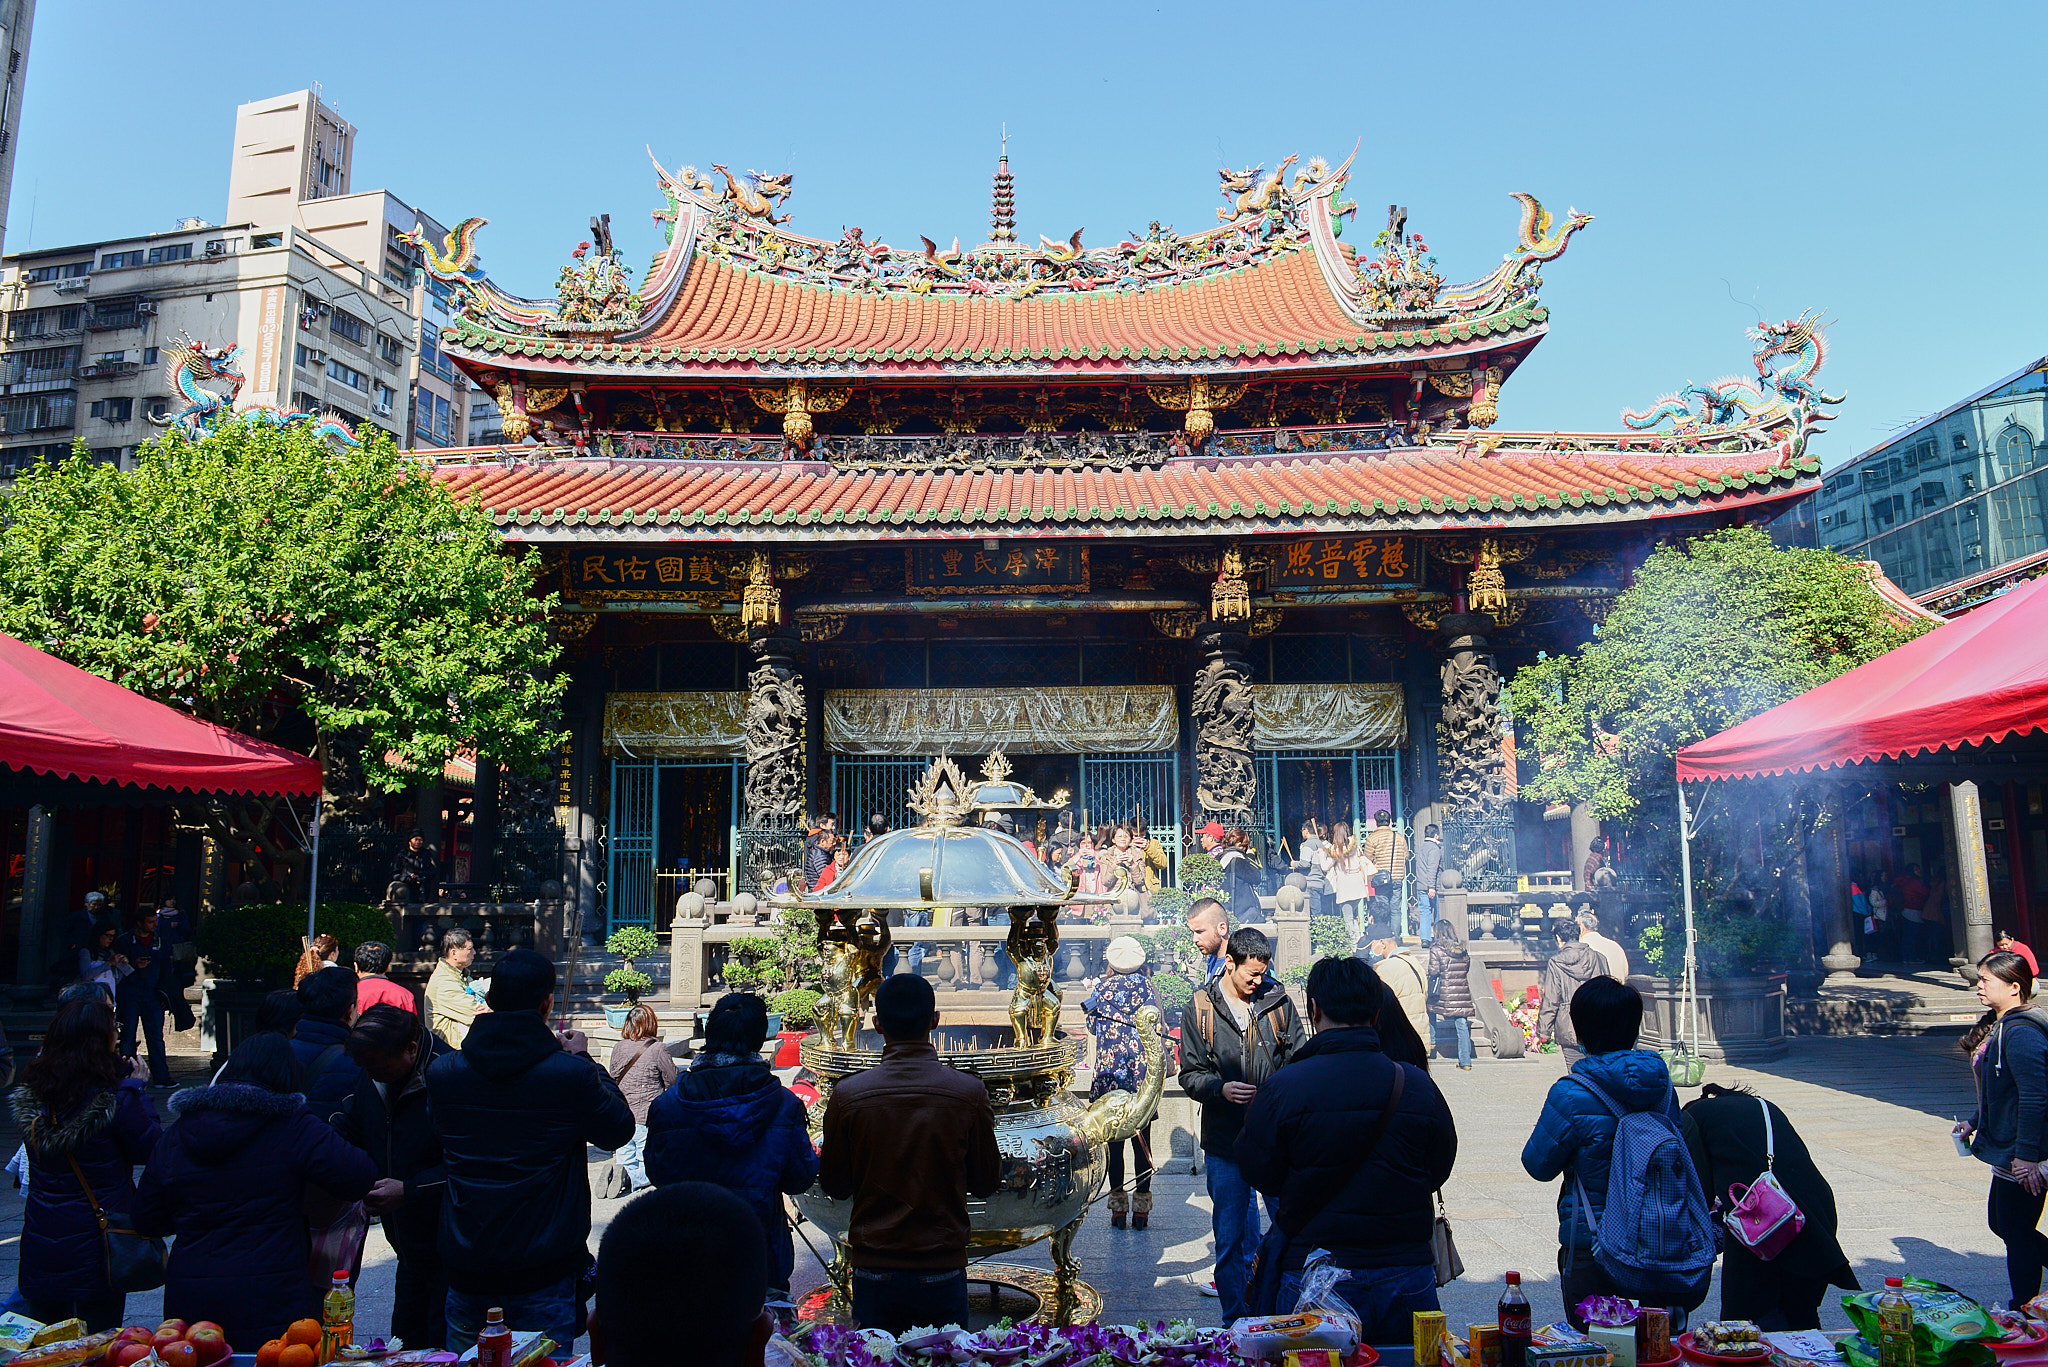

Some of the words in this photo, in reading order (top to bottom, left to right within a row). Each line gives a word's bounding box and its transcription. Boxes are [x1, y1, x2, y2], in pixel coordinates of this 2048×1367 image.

[259, 322, 280, 334] (02)
[582, 555, 720, 586] 護國佑民
[1282, 537, 1409, 579] 慈雲普照
